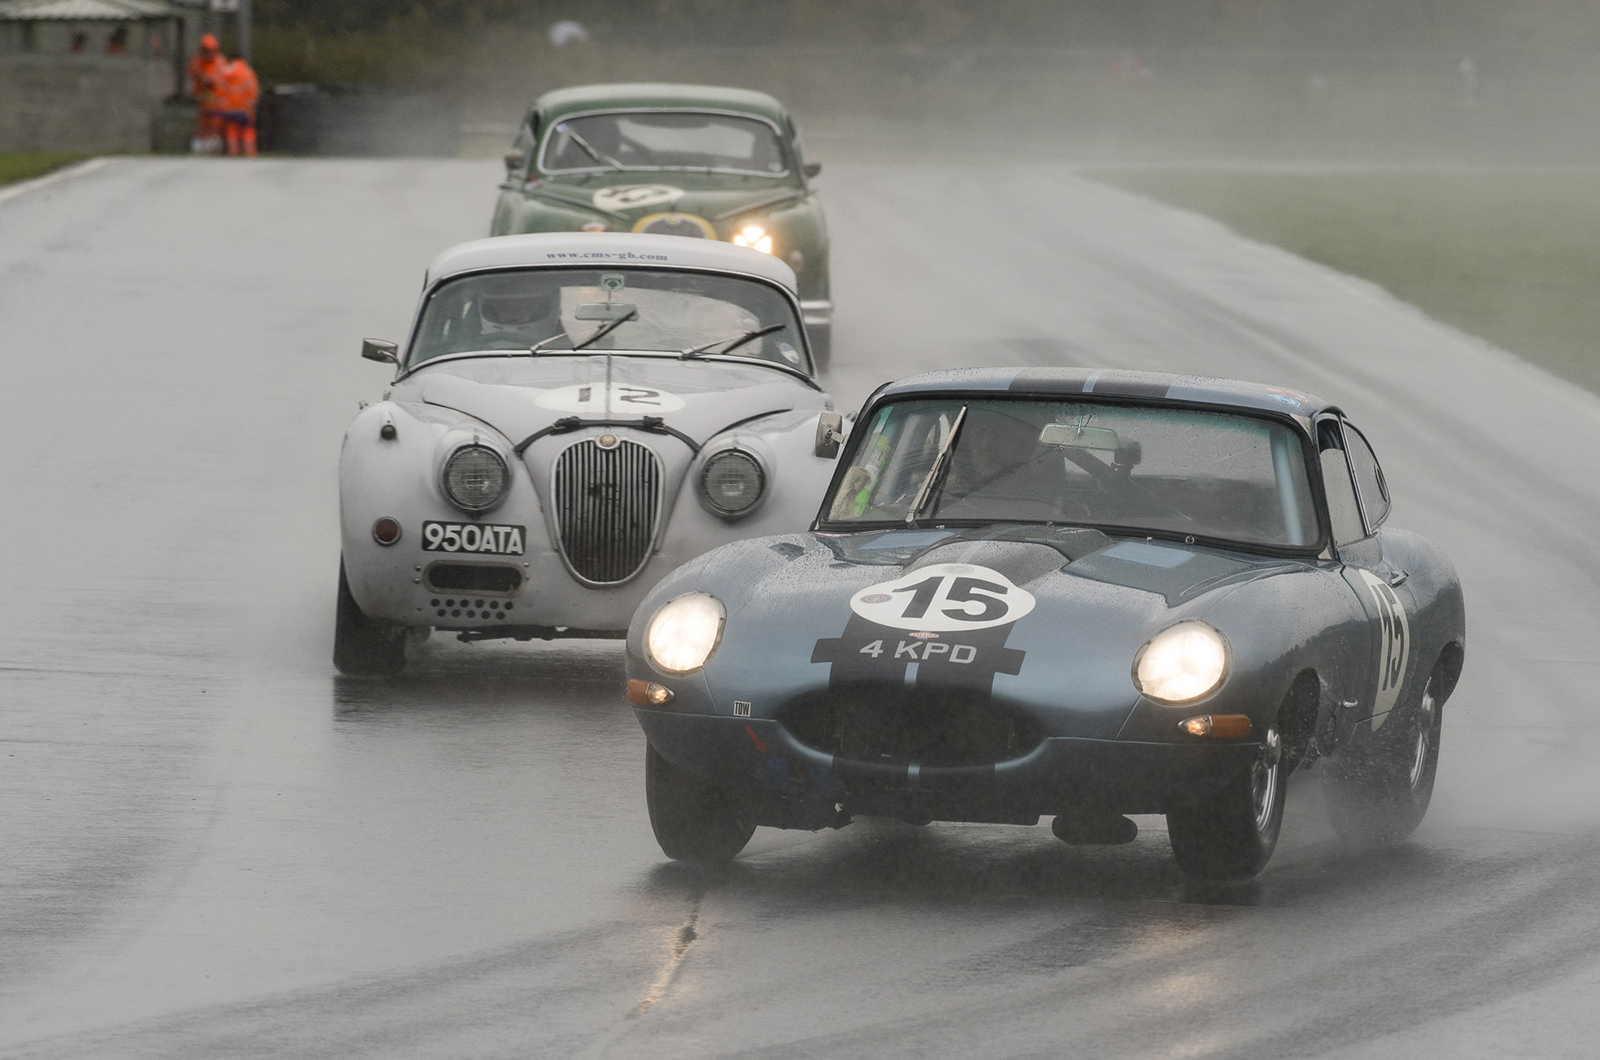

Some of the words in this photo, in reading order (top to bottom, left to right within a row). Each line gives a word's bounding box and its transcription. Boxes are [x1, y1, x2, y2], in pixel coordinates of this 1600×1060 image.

[546, 252, 669, 261] www.cms-gb.com
[578, 387, 662, 406] 12
[425, 523, 524, 555] 950ATA
[892, 576, 1009, 622] 15
[1371, 583, 1405, 691] 15
[859, 640, 883, 658] 4
[894, 640, 977, 664] KPD
[734, 702, 750, 716] TOW
